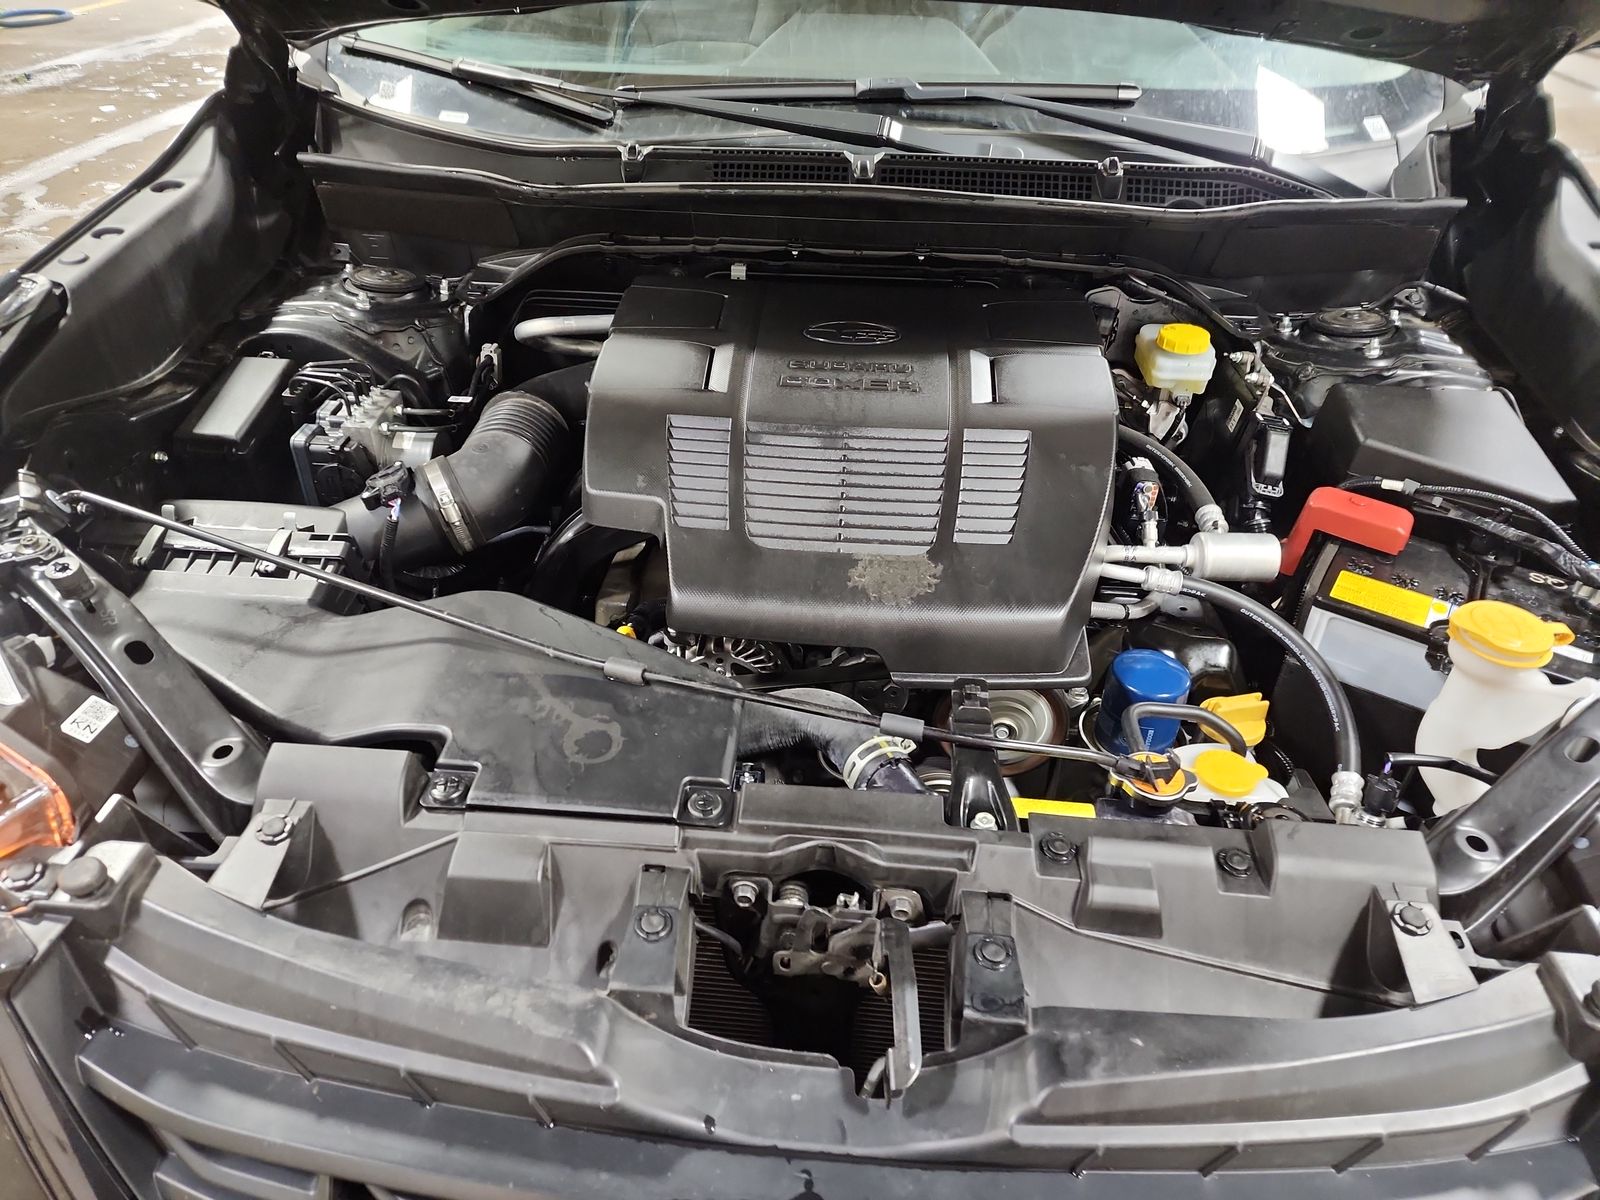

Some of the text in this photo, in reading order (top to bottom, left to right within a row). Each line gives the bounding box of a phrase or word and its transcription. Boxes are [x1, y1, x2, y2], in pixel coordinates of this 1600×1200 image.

[787, 359, 914, 374] SUBARU
[777, 374, 922, 394] BOXER
[70, 718, 98, 735] KN
